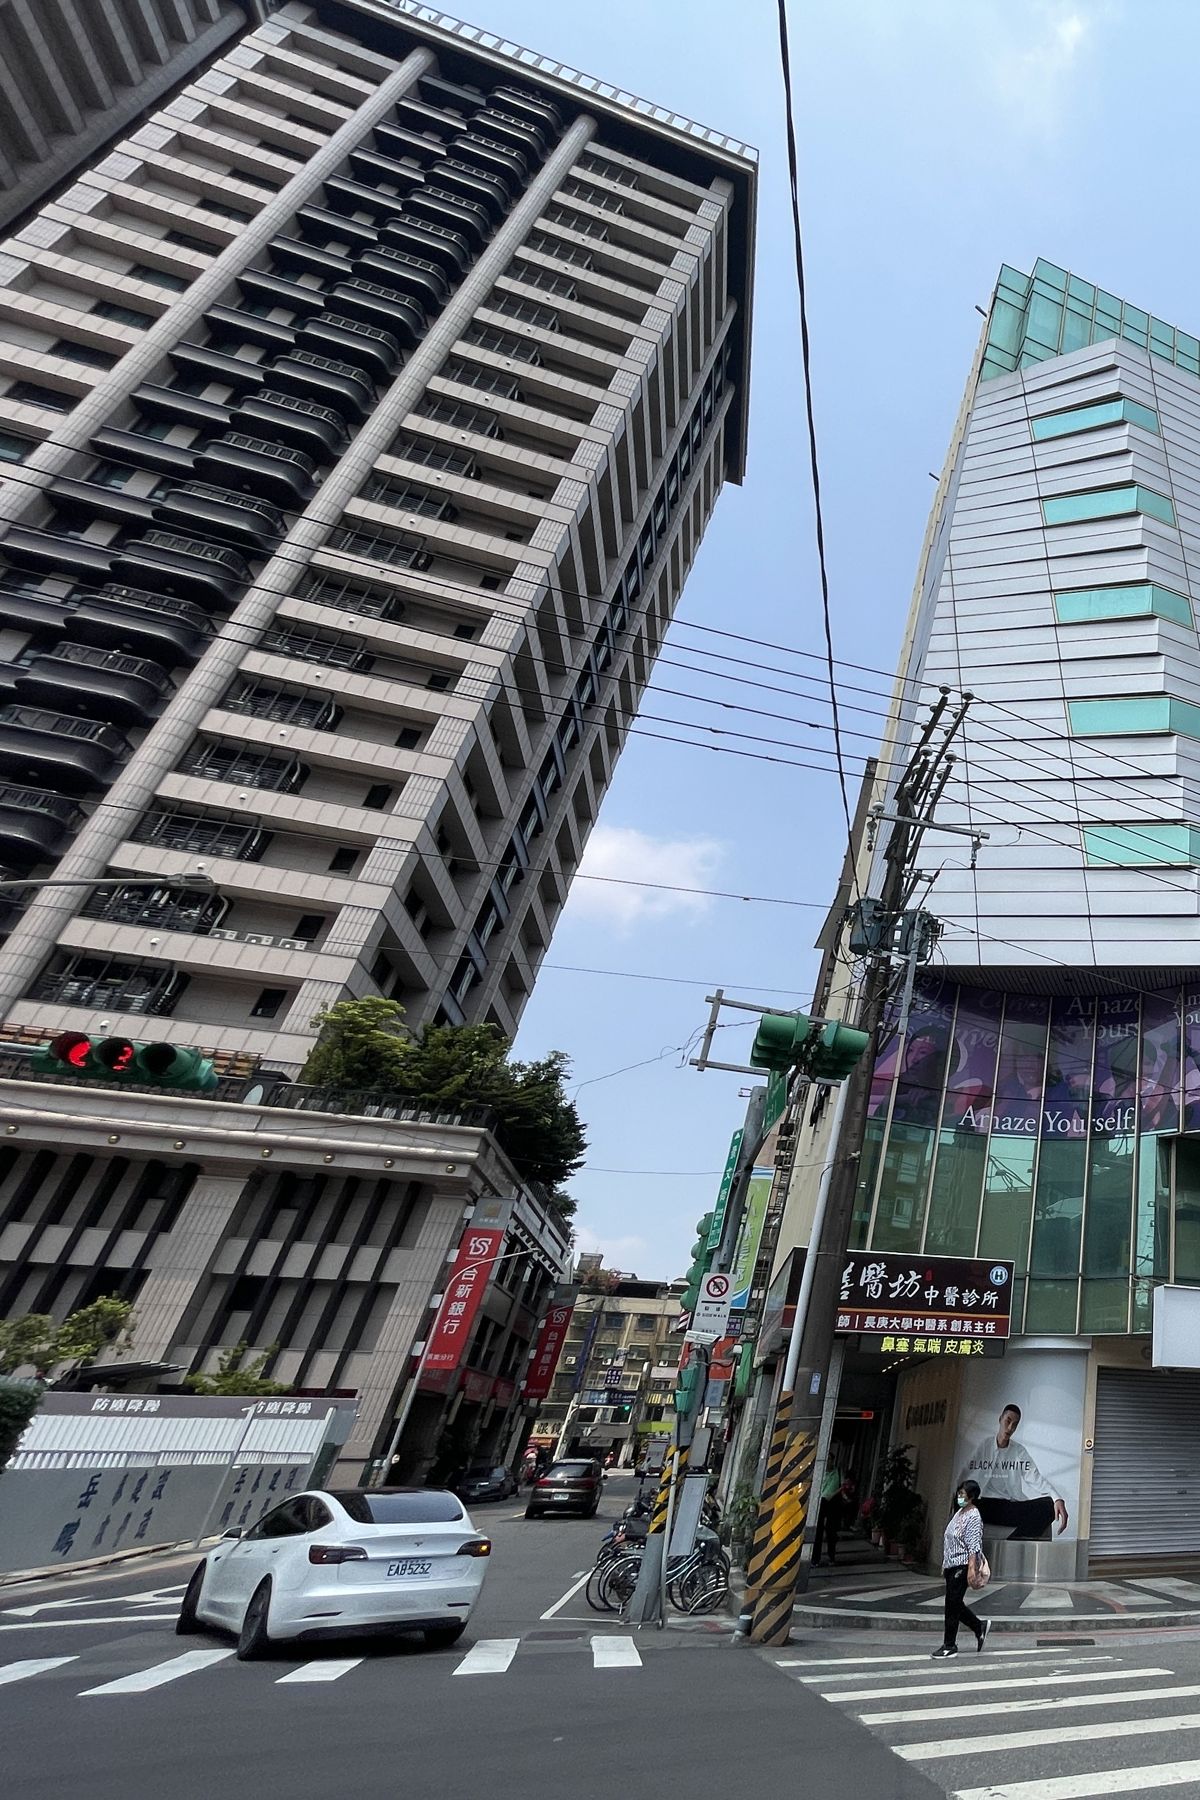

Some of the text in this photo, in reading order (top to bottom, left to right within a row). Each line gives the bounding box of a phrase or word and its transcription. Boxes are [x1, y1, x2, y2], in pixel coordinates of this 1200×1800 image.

[443, 1268, 479, 1335] 台新銀行
[925, 1285, 999, 1309] 中醫診所
[864, 1315, 948, 1331] 長庚大學中醫系
[951, 1319, 996, 1334] 創系主任
[881, 1336, 985, 1355] 鼻塞 氣喘 皮膚炎
[969, 1460, 993, 1470] BLACK
[1001, 1460, 1031, 1471] WHITE
